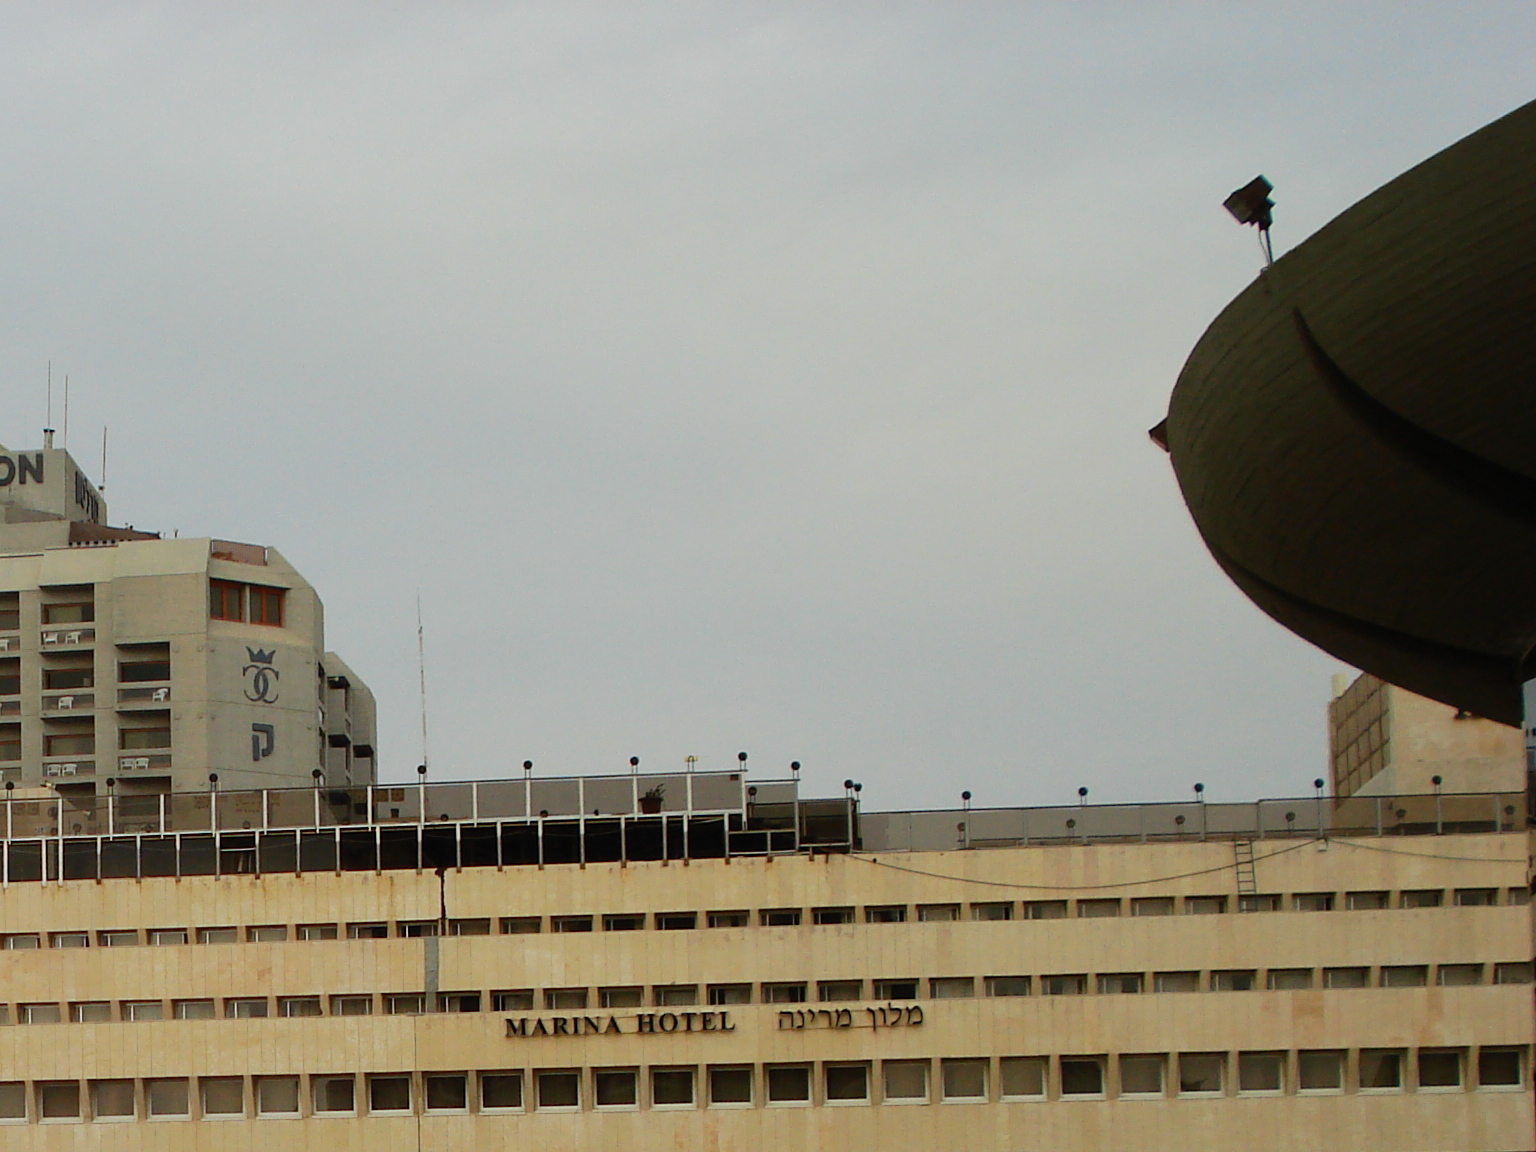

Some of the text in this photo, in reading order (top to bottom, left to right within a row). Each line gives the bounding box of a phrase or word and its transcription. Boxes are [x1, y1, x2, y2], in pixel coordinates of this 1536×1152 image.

[505, 1011, 736, 1037] MARINA HOTEL
[779, 1002, 923, 1032] מלון מרינה
